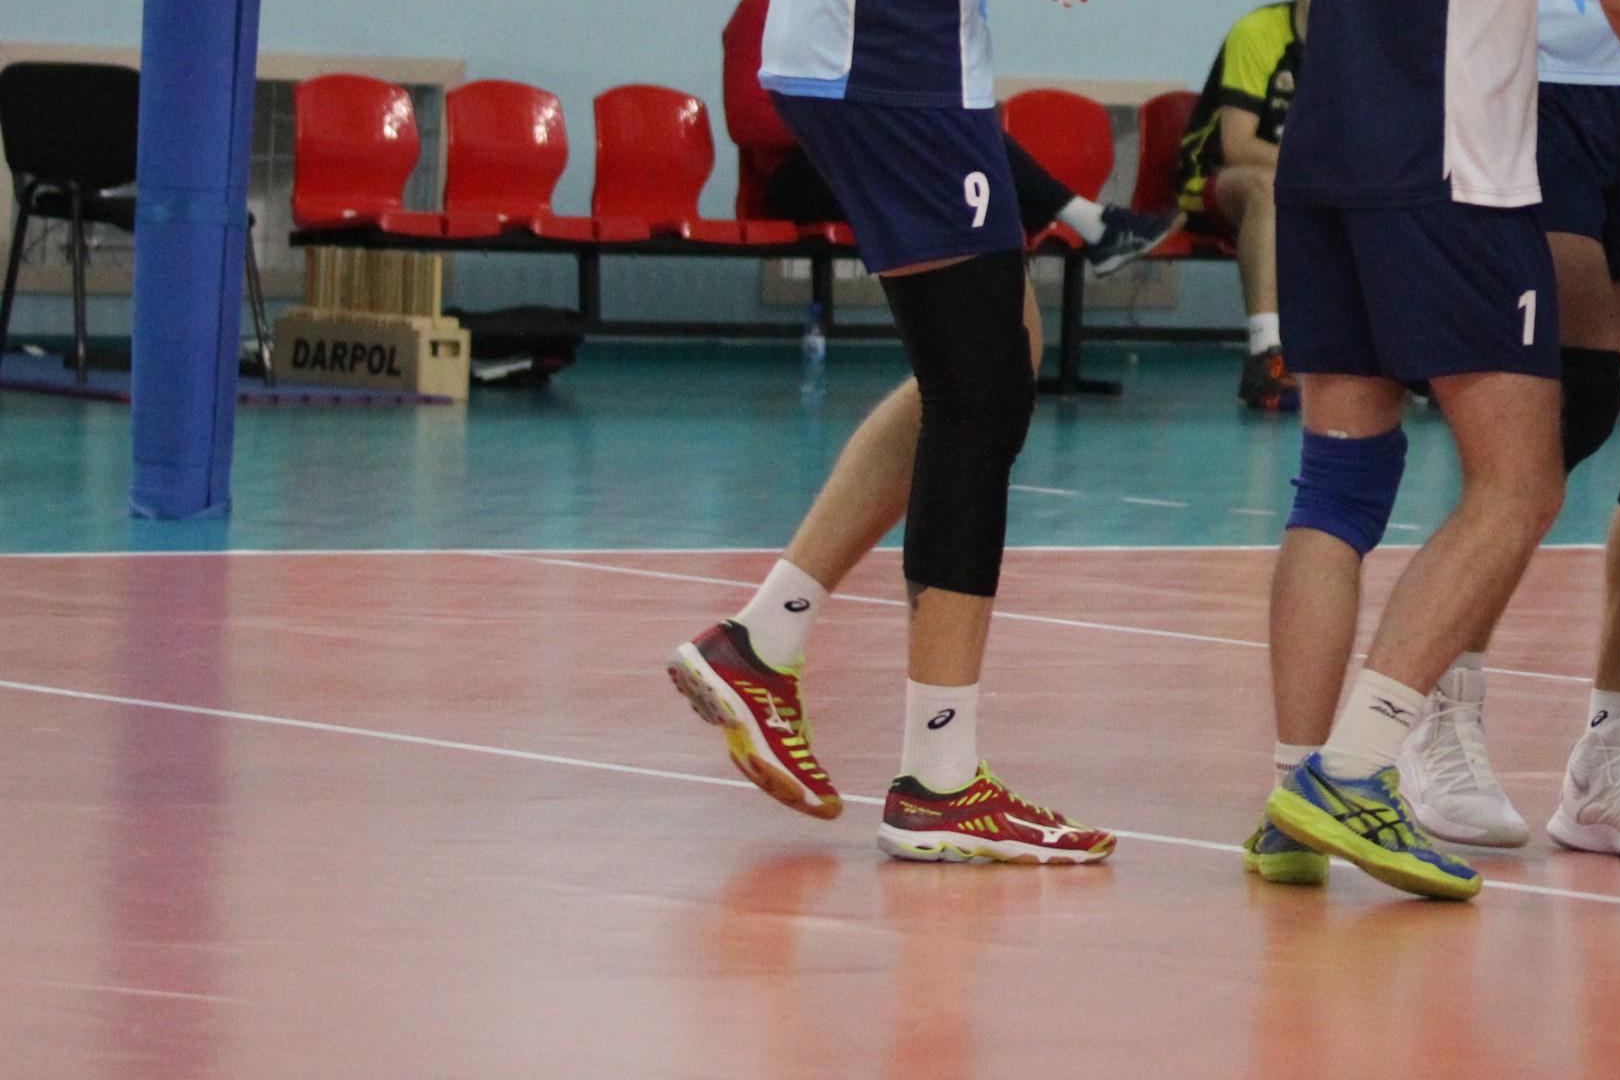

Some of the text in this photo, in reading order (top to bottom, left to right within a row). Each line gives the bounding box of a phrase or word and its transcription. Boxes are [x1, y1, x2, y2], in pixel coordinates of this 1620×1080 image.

[963, 171, 991, 228] 9
[1517, 289, 1537, 346] 1
[292, 338, 400, 377] DARPOL
